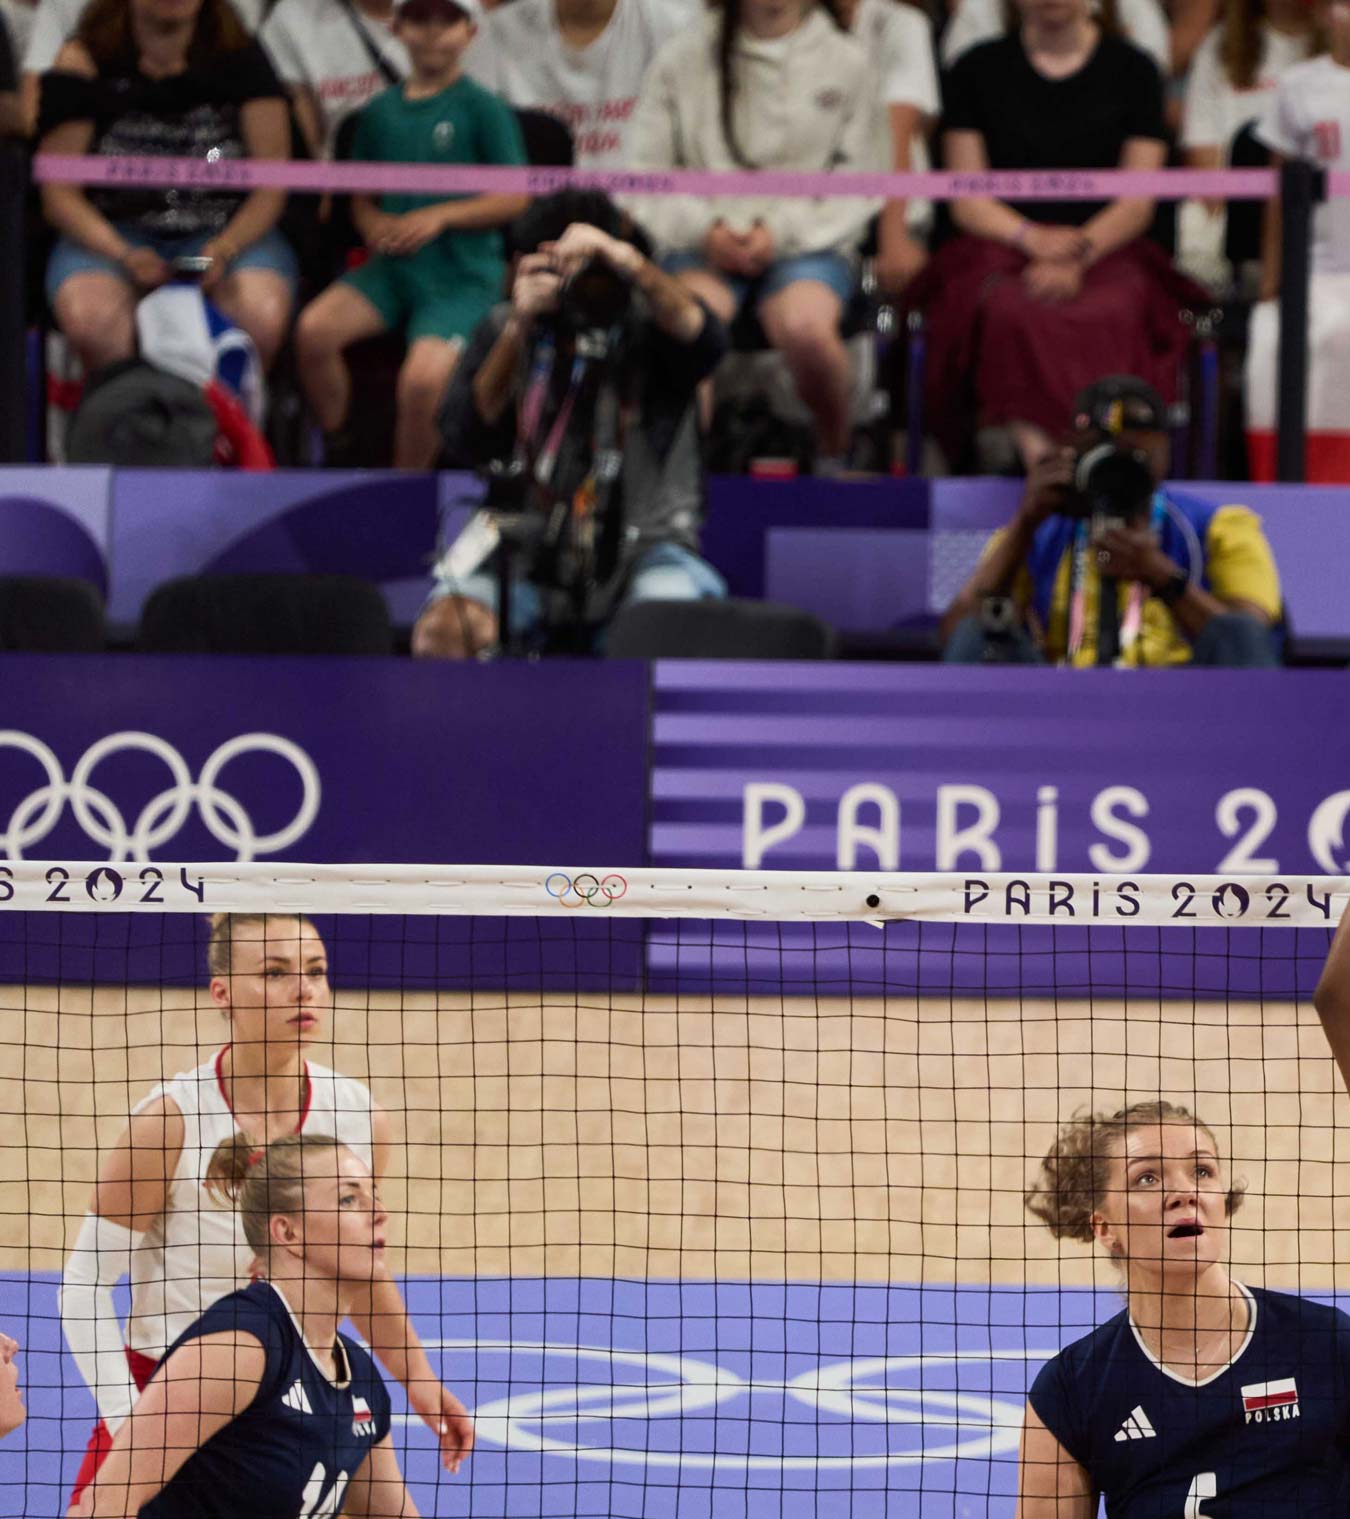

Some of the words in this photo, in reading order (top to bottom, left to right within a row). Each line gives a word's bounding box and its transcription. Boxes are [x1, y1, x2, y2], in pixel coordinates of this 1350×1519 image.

[45, 867, 204, 903] 2024
[1171, 882, 1331, 919] 2024
[1244, 1404, 1301, 1425] POLSKA
